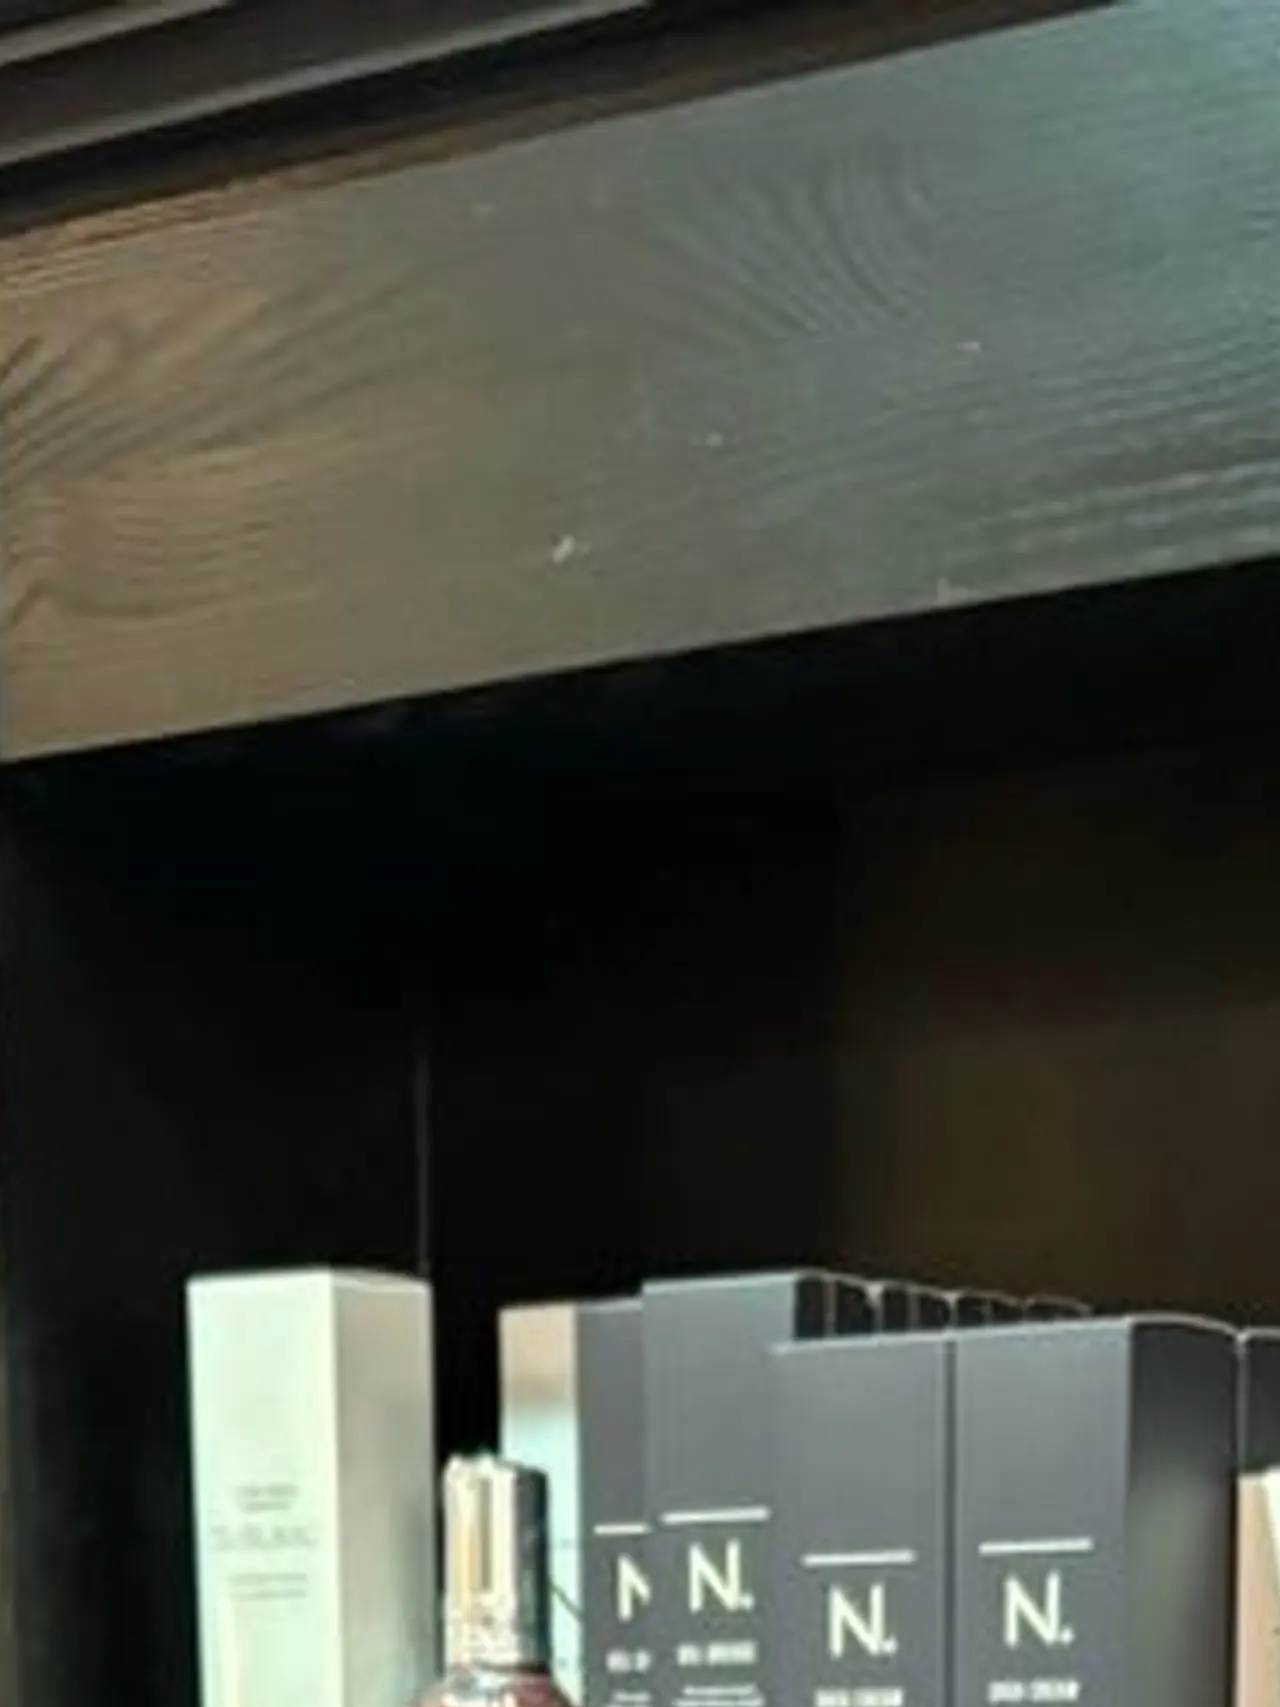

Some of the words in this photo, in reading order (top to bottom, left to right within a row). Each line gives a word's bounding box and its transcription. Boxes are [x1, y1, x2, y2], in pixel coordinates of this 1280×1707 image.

[616, 1551, 652, 1624] N
[686, 1536, 755, 1614] N.
[1004, 1567, 1075, 1649] N.
[828, 1582, 899, 1659] N.
